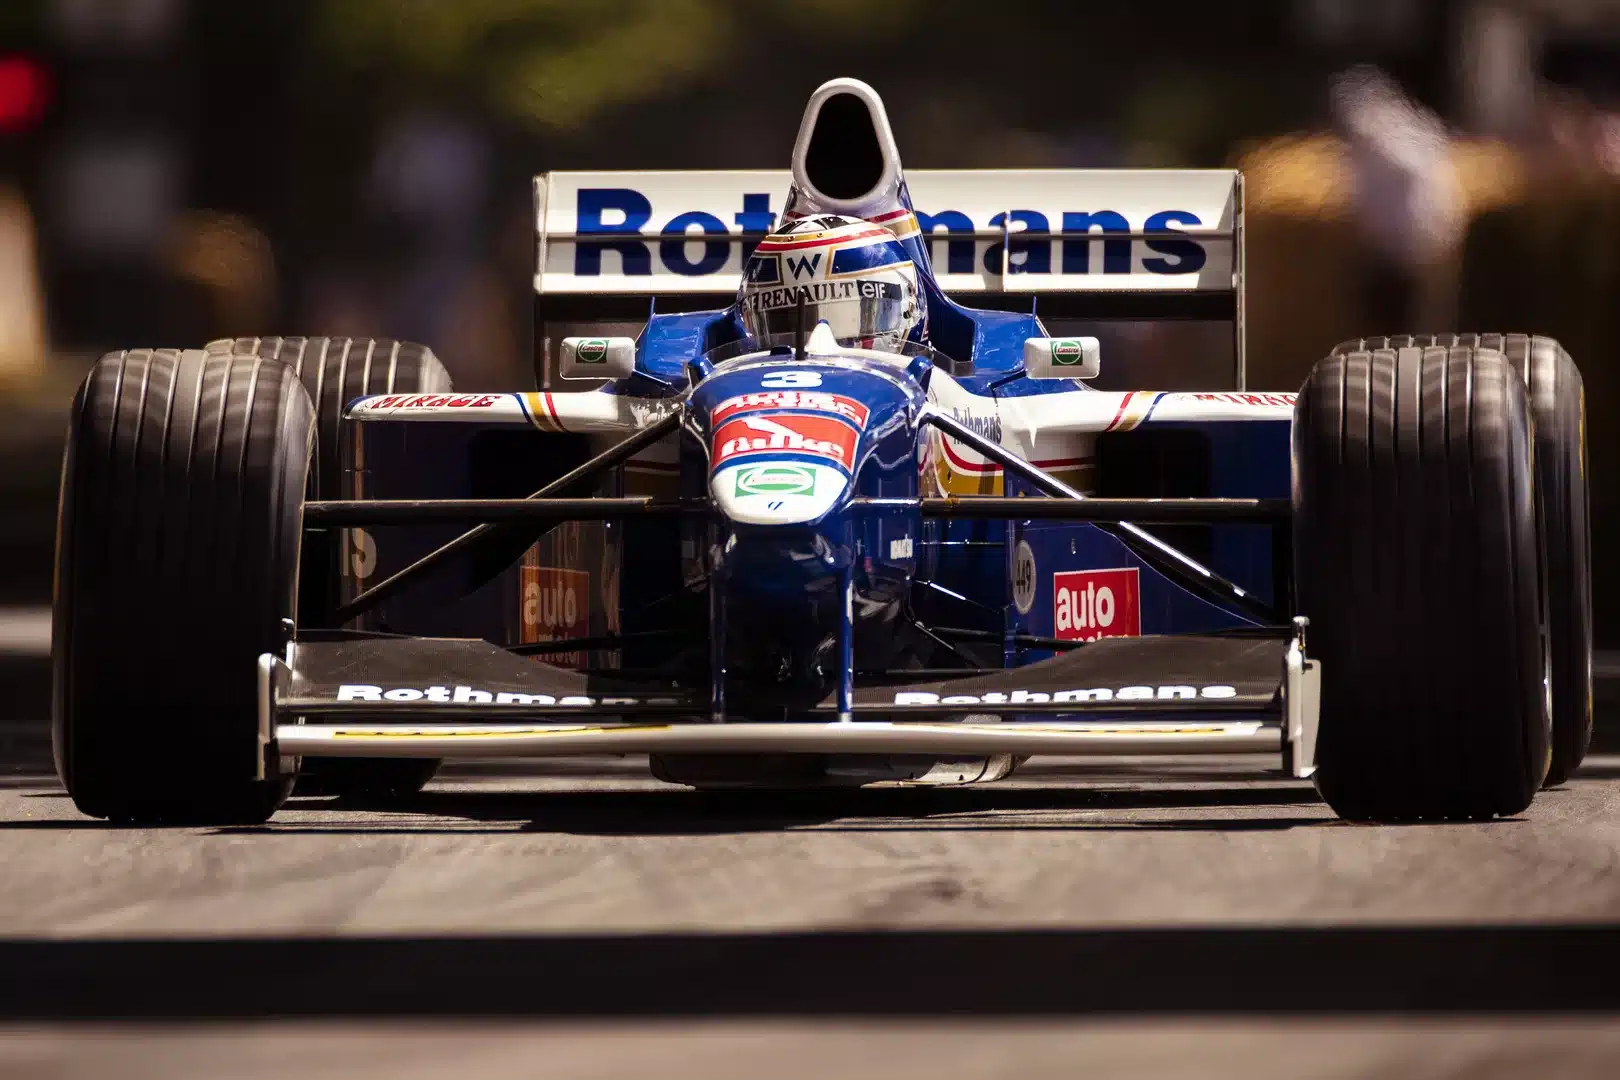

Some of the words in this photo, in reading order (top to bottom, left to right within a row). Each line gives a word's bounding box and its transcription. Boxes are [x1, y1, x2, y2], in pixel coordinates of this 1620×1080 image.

[575, 187, 1206, 276] Rotmans
[761, 282, 855, 309] RENAULT
[861, 282, 887, 299] elf
[761, 371, 822, 388] 3
[371, 395, 503, 409] MIRAGE
[1016, 559, 1031, 595] 449
[524, 581, 577, 628] auto
[1057, 581, 1115, 631] auto
